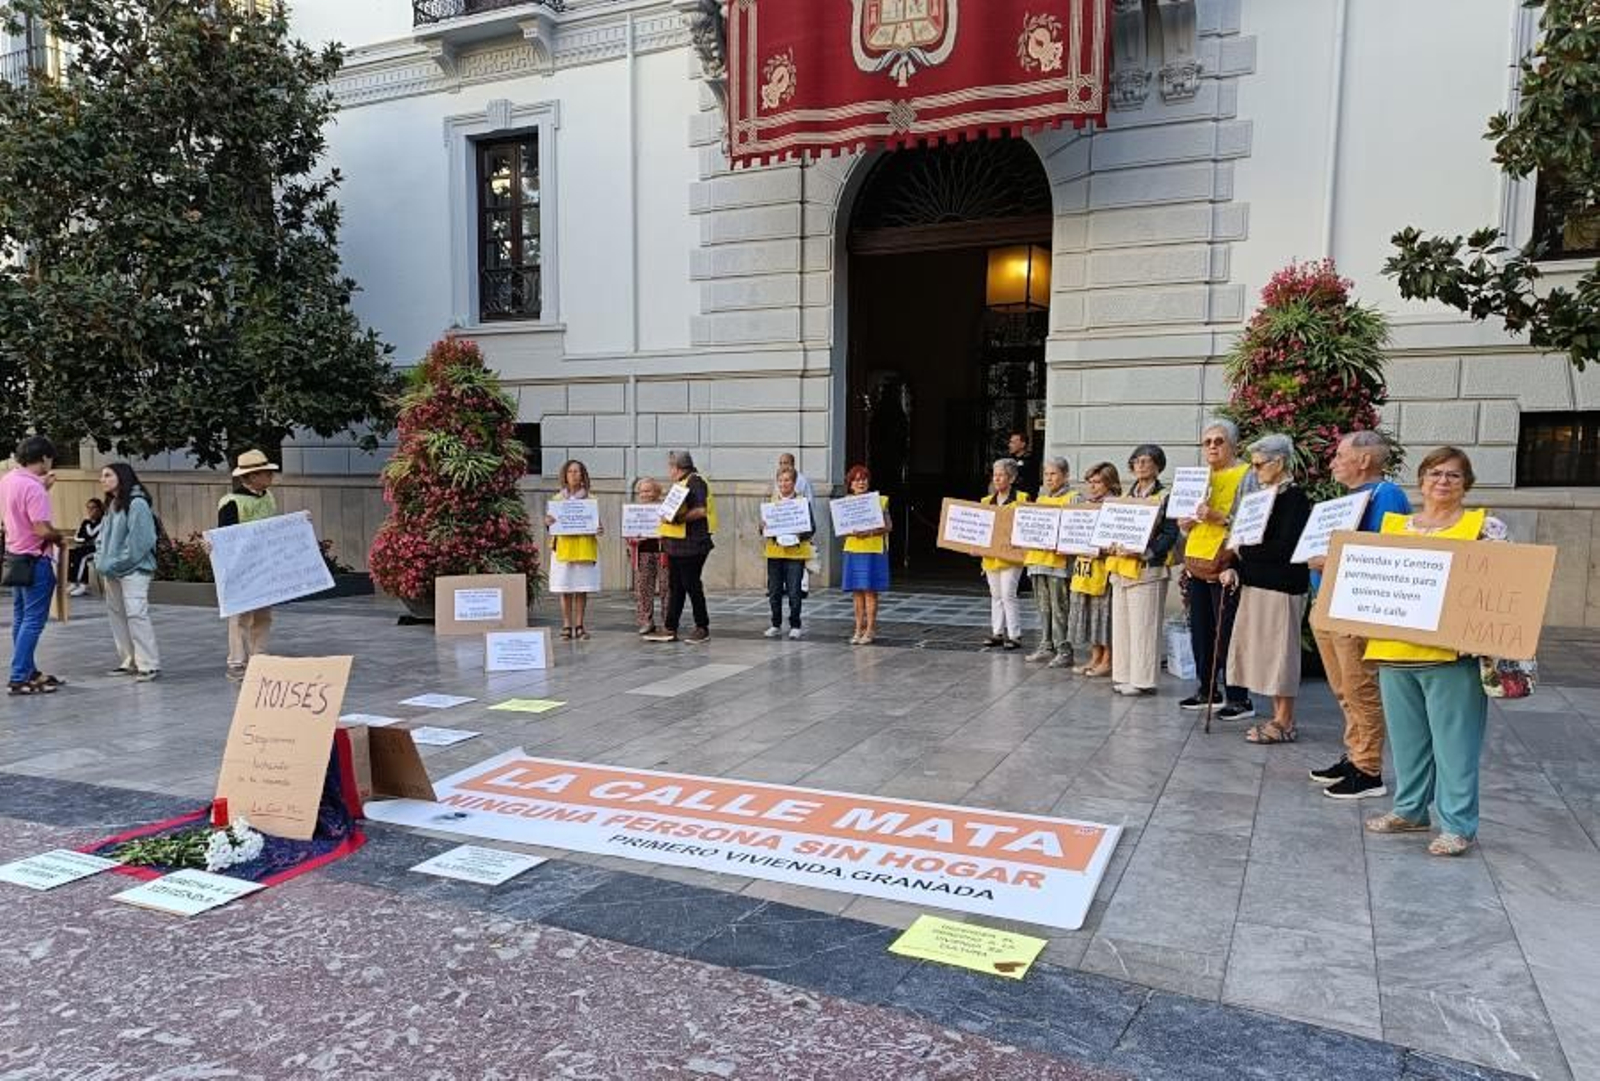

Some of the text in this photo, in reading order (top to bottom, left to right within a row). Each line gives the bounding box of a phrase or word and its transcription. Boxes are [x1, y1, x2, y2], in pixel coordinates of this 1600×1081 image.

[1345, 553, 1445, 571] Viviendas y Centros
[1465, 553, 1489, 575] LA
[1344, 569, 1437, 588] permanentes para
[1352, 585, 1422, 602] quienes viven
[1357, 602, 1407, 617] en la calle
[1458, 583, 1522, 615] CALLE
[1462, 616, 1523, 648] MATA
[255, 674, 331, 714] MOISÉS
[484, 767, 1065, 858] LA CALLE MATA
[438, 794, 1047, 890] NINGUNA PERSONA SIN HOGAR
[608, 833, 719, 858] PRIMERO
[851, 869, 995, 900] GRANADA
